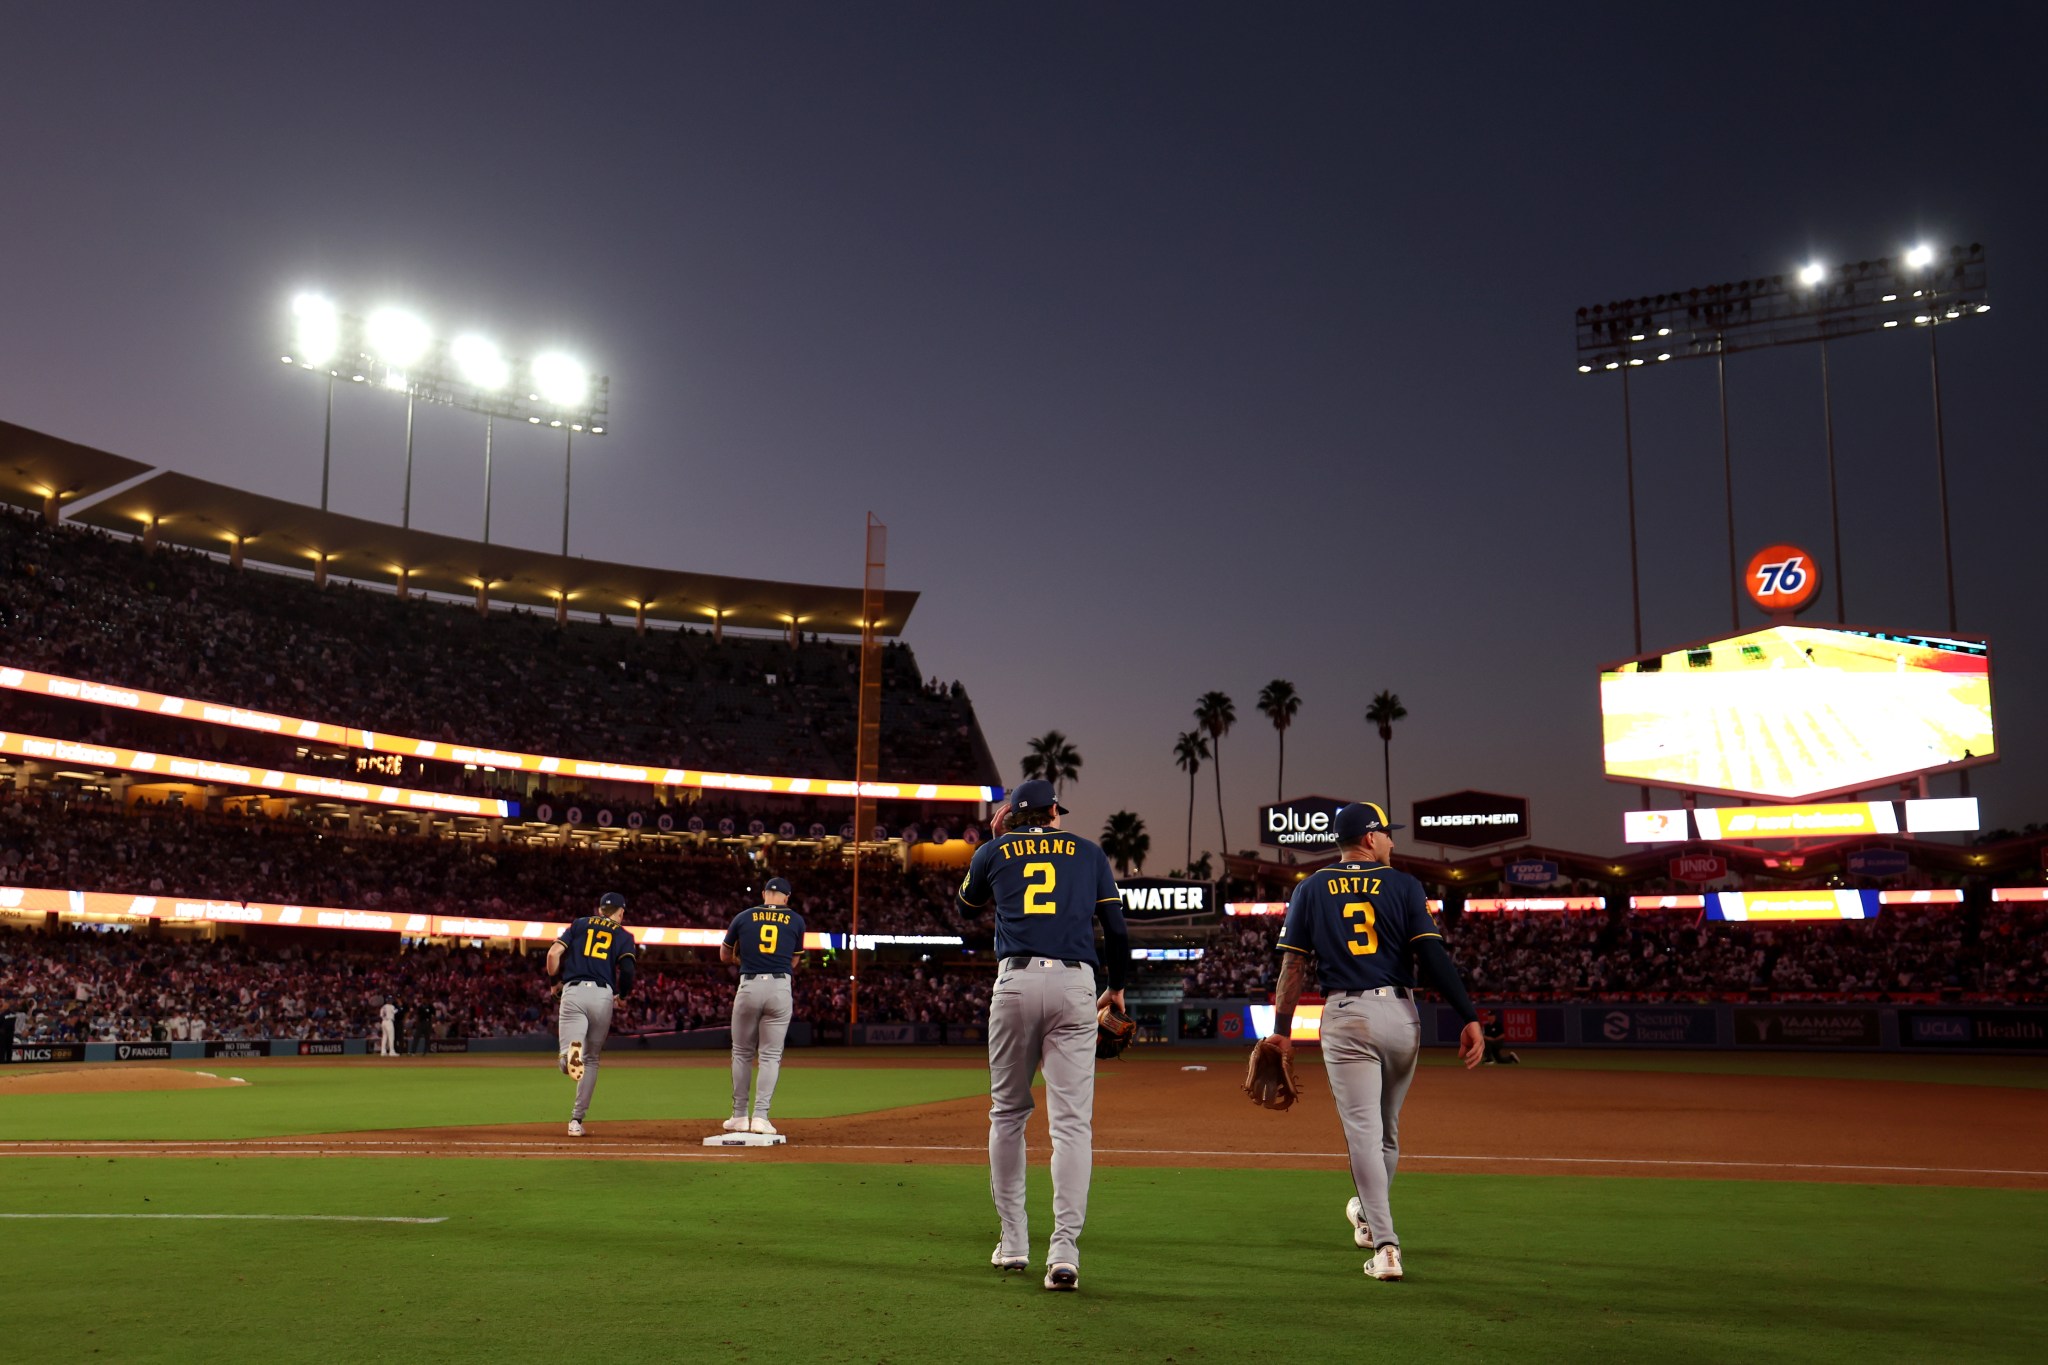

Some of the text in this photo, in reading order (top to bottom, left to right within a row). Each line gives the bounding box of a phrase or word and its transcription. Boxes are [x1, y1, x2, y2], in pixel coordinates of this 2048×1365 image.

[1756, 556, 1806, 596] 76
[48, 680, 80, 696] new
[80, 682, 139, 707] balance
[23, 740, 55, 756] new
[56, 741, 116, 764] balance
[1268, 807, 1329, 832] blue
[1420, 813, 1519, 827] GUGGENHEIM
[1278, 831, 1337, 844] california
[1000, 838, 1076, 860] TURANG
[1512, 865, 1543, 873] TOYO
[1680, 859, 1718, 876] JINRO
[1517, 872, 1552, 881] TIRES
[1023, 862, 1057, 915] 2
[1327, 876, 1383, 896] ORTIZ
[176, 903, 206, 917] new
[206, 901, 262, 921] balance
[752, 911, 791, 925] BAUERS
[588, 917, 620, 931] PRATT
[1342, 900, 1379, 956] 3
[583, 928, 613, 960] 12
[758, 924, 779, 955] 9
[1223, 1017, 1239, 1033] 76
[1507, 1013, 1531, 1024] UNI
[1635, 1012, 1693, 1028] Security
[870, 1029, 895, 1041] ANA
[1508, 1026, 1533, 1040] QLO
[1636, 1028, 1685, 1040] Benefit
[1919, 1021, 2044, 1038] UCLA Health
[24, 1048, 51, 1061] NLCS
[132, 1047, 169, 1057] FANDUEL
[310, 1043, 342, 1053] STRAUSS
